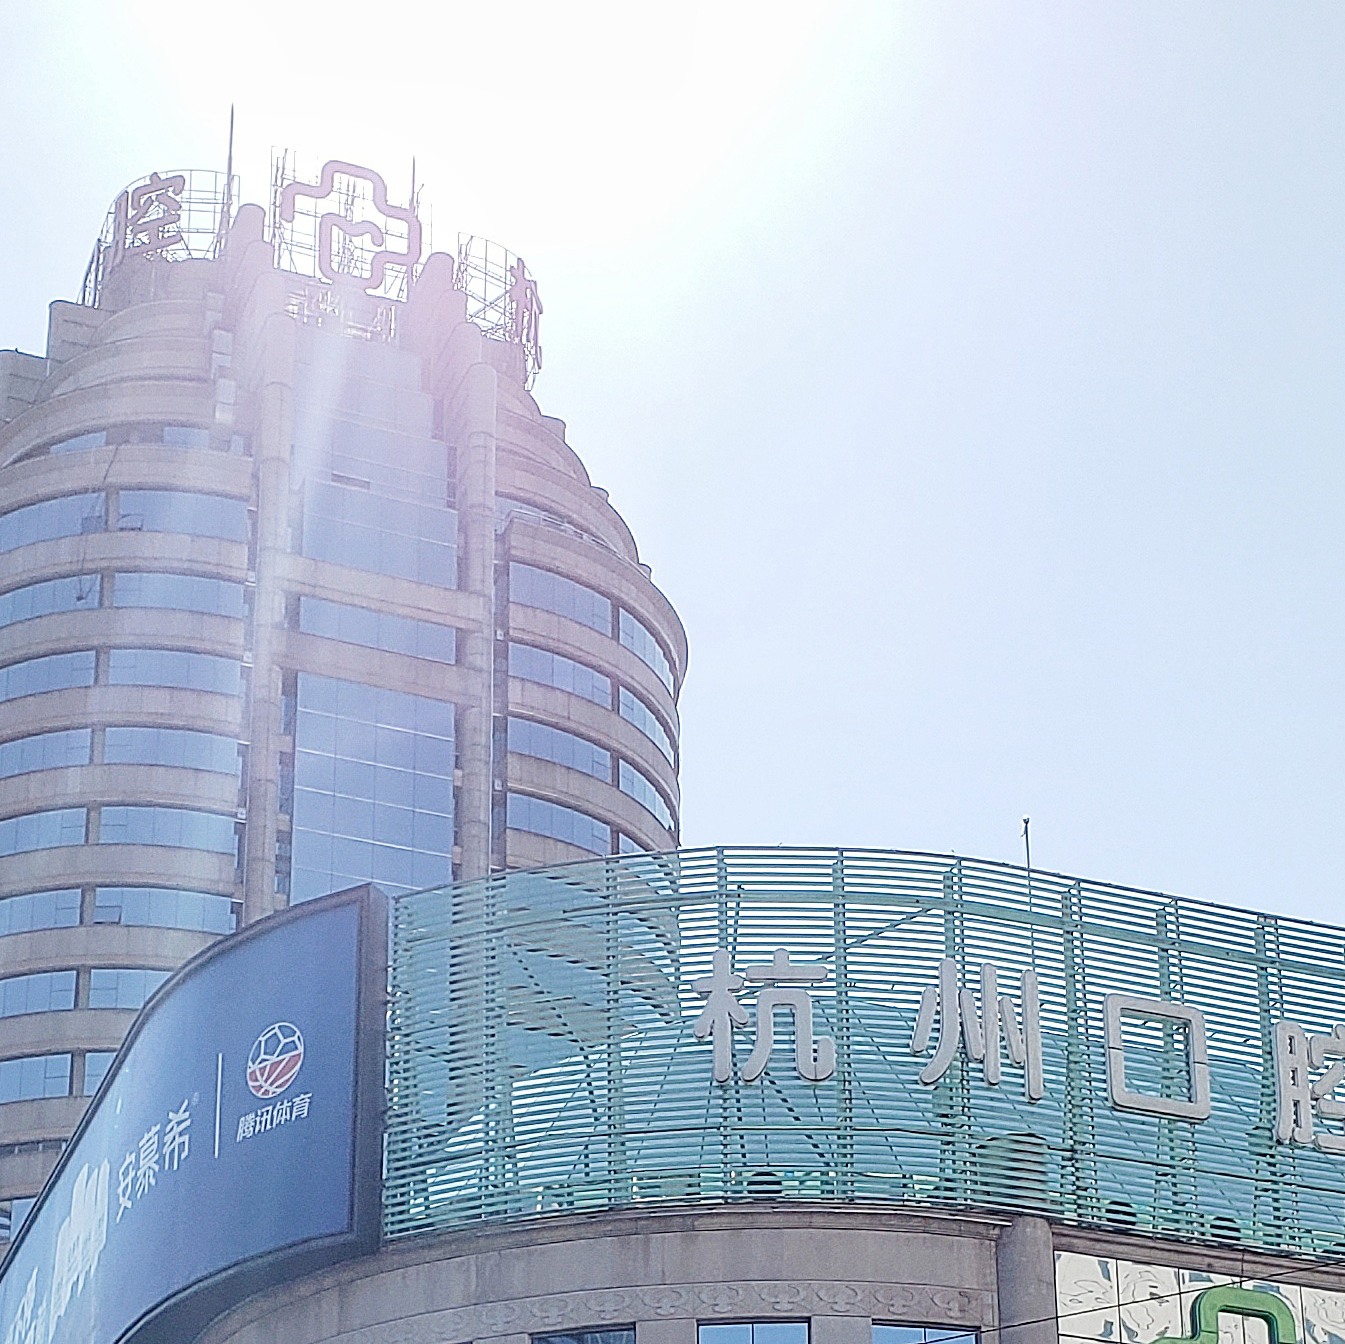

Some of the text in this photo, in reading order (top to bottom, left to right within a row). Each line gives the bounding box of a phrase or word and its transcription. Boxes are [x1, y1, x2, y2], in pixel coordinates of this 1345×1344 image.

[116, 1092, 313, 1223] 安慕希 腾讯体育
